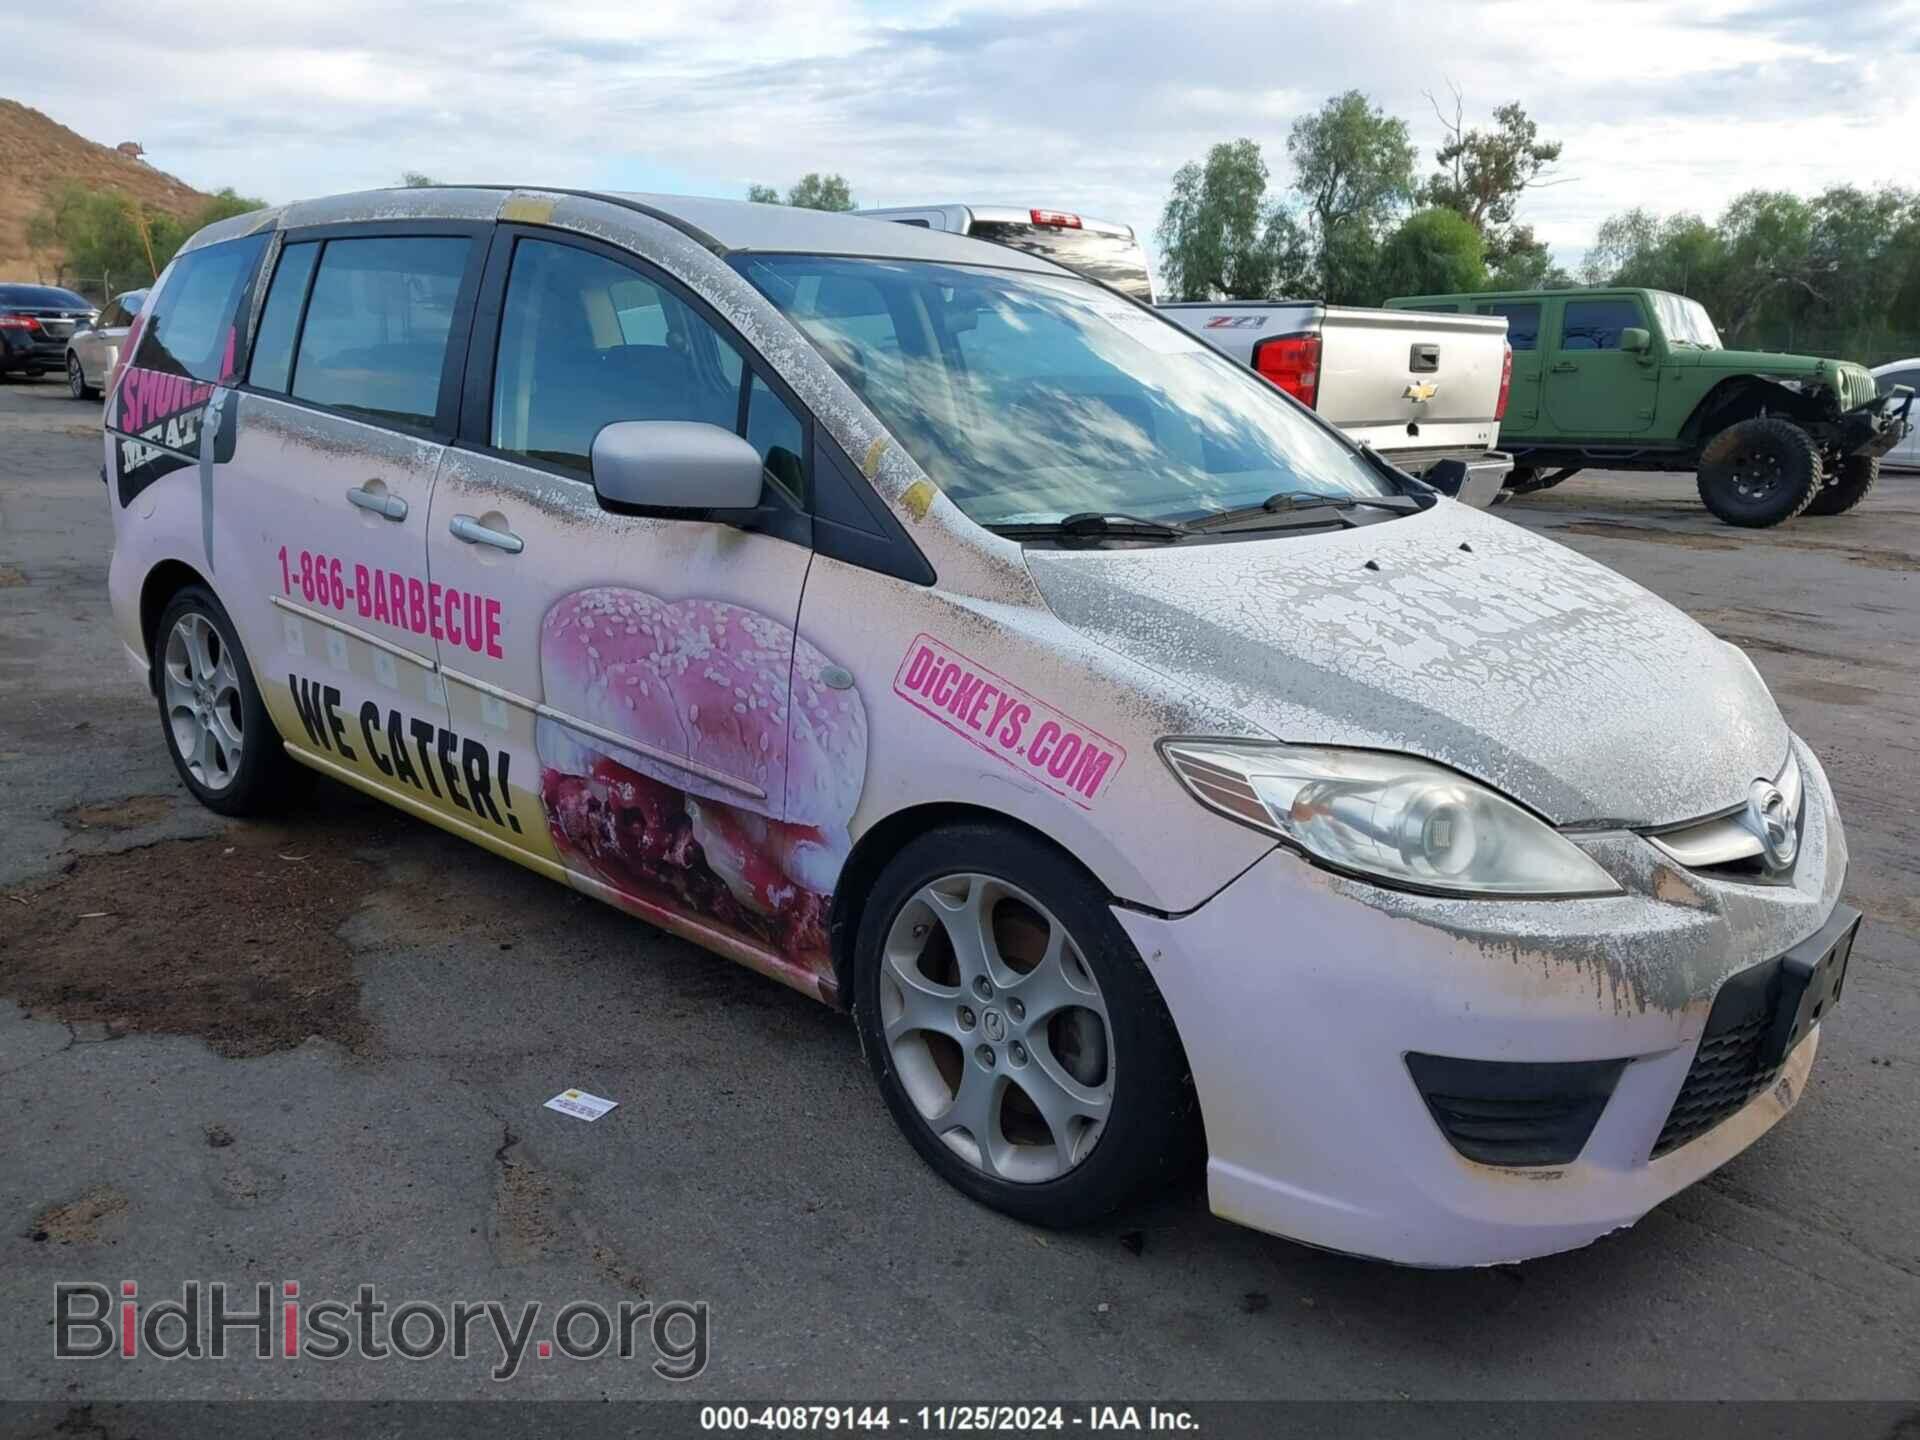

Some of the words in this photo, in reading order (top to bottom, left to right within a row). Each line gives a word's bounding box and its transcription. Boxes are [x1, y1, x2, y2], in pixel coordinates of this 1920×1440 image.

[278, 545, 503, 659] 1-866-BARBECUE
[289, 674, 358, 761] WE
[360, 701, 523, 835] CATER!
